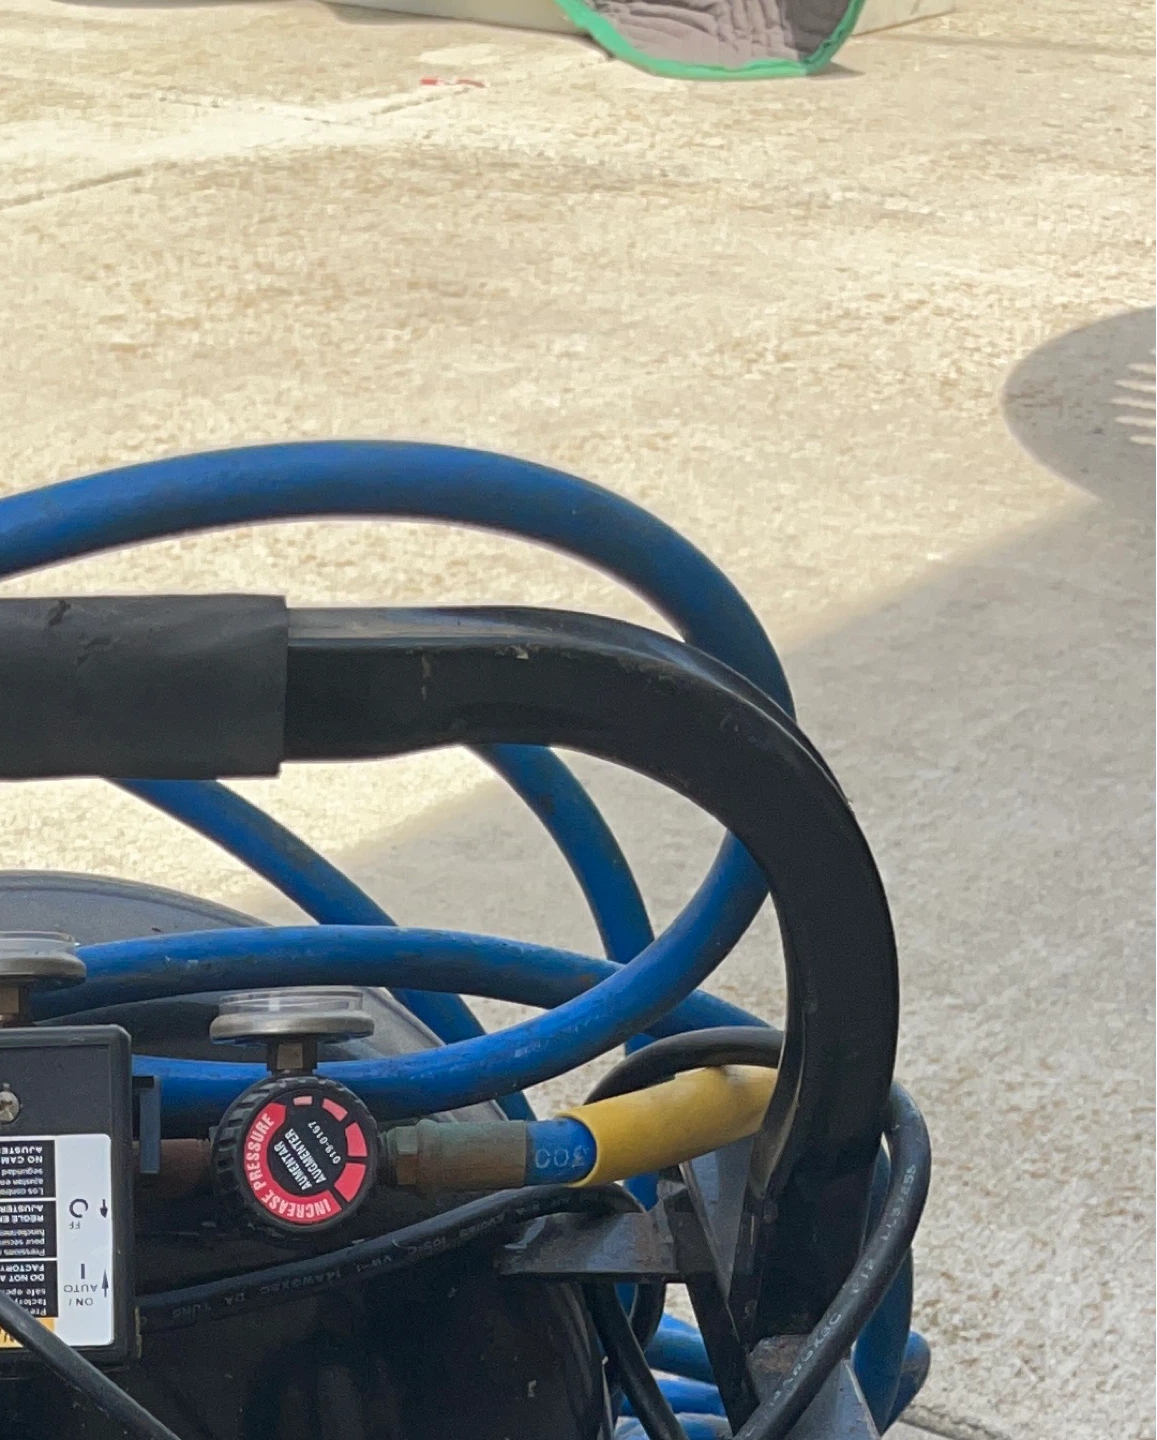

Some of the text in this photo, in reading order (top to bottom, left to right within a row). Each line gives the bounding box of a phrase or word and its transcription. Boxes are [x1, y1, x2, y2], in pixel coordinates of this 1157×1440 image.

[246, 1113, 331, 1218] INCREASE PRESSURE
[274, 1141, 312, 1190] AUMENTAR
[284, 1128, 326, 1184] AUGMENTER
[307, 1121, 341, 1164] 019-0167
[64, 1284, 98, 1293] AUTO
[76, 1298, 93, 1306] ON
